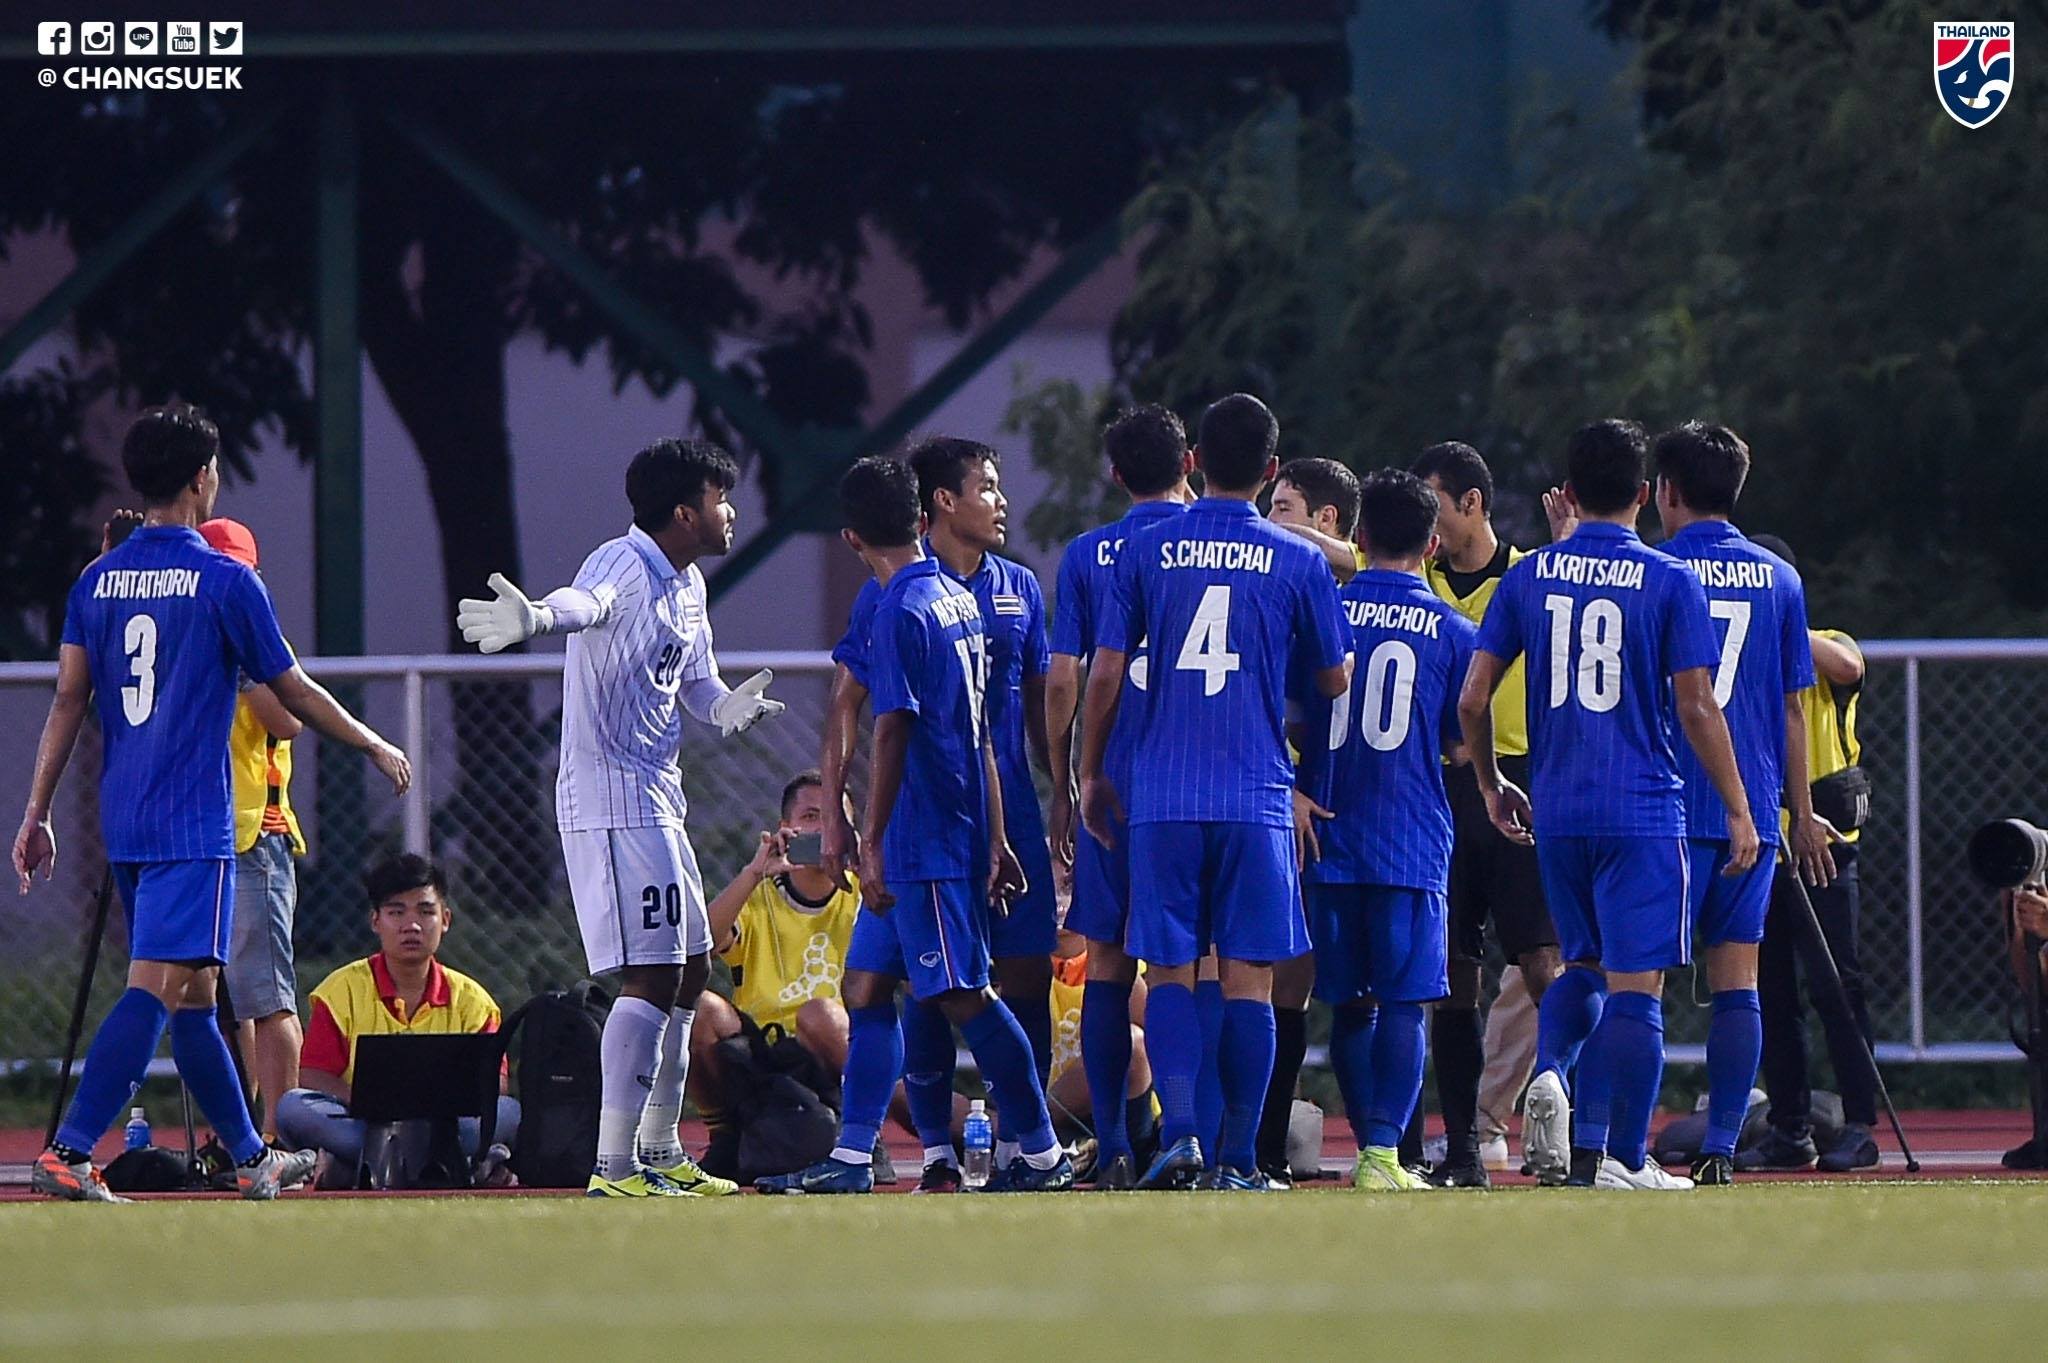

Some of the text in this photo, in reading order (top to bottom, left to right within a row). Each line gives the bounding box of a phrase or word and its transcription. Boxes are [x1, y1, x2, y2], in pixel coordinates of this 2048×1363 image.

[93, 568, 201, 599] A.THITATHORN
[1160, 539, 1274, 574] S.CHATCHAI
[1536, 551, 1645, 591] K.KRITSADA
[121, 614, 157, 727] 3
[655, 642, 683, 686] 20
[1175, 585, 1240, 697] 4
[1545, 594, 1623, 713] 18
[1709, 600, 1752, 711] 7
[954, 633, 986, 750] 17
[642, 883, 682, 930] 20
